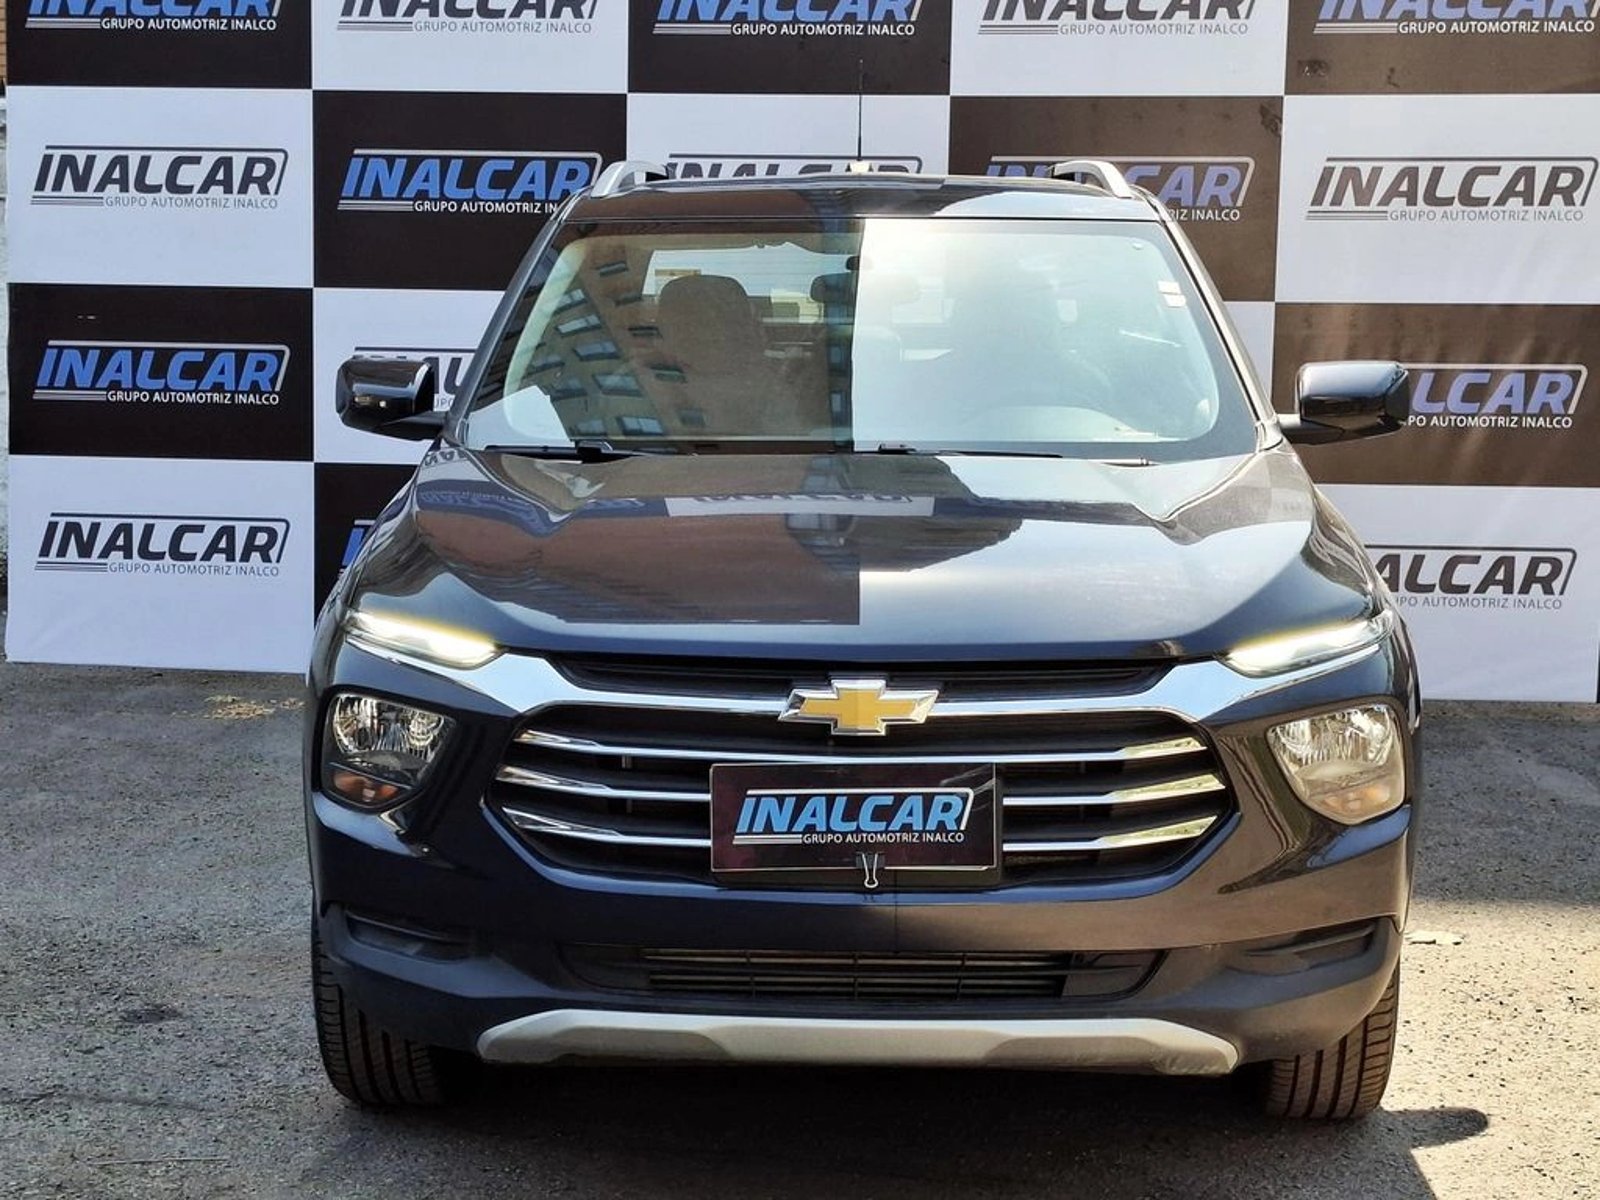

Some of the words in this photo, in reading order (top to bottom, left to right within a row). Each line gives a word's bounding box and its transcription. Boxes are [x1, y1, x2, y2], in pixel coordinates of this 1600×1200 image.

[101, 18, 144, 30] GRUPO
[148, 18, 228, 31] AUTOMOTRIZ
[231, 19, 277, 31] INALCO
[414, 20, 457, 32] GRUPO
[461, 21, 541, 33] AUTOMOTRIZ
[546, 21, 592, 33] INALCO
[732, 23, 777, 36] GRUPO
[780, 24, 864, 36] AUTOMOTRIZ
[867, 24, 915, 36] INALCO
[1060, 23, 1105, 35] GRUPO
[1109, 23, 1195, 35] AUTOMOTRIZ
[1200, 23, 1249, 35] INALCO
[1400, 20, 1446, 33] GRUPO
[1450, 20, 1540, 33] AUTOMOTRIZ
[1544, 20, 1595, 33] INALCO
[34, 154, 277, 195] INALCAR
[341, 157, 591, 200] INALCAR
[1310, 165, 1585, 208] INALCAR
[105, 196, 148, 208] GRUPO
[151, 197, 230, 209] AUTOMOTRIZ
[233, 197, 278, 209] INALCO
[414, 201, 457, 213] GRUPO
[460, 202, 541, 213] AUTOMOTRIZ
[1191, 208, 1241, 221] INALCO
[1389, 210, 1437, 222] GRUPO
[1441, 210, 1529, 222] AUTOMOTRIZ
[1533, 210, 1584, 222] INALCO
[36, 348, 278, 391] INALCAR
[107, 390, 150, 403] GRUPO
[153, 391, 232, 404] AUTOMOTRIZ
[235, 392, 280, 405] INALCO
[1411, 371, 1574, 415] LCAR
[1430, 415, 1518, 428] AUTOMOTRIZ
[1521, 415, 1573, 429] INALCO
[38, 521, 279, 564] INALCAR
[109, 562, 151, 574] GRUPO
[154, 563, 233, 576] AUTOMOTRIZ
[236, 564, 280, 577] INALCO
[1373, 554, 1563, 596] ALCAR
[1422, 596, 1509, 608] AUTOMOTRIZ
[1512, 597, 1562, 610] INALCO
[736, 795, 964, 833] INALCAR
[803, 833, 843, 844] GRUPO
[846, 833, 919, 844] AUTOMOTRIZ
[922, 832, 965, 844] INALCO
